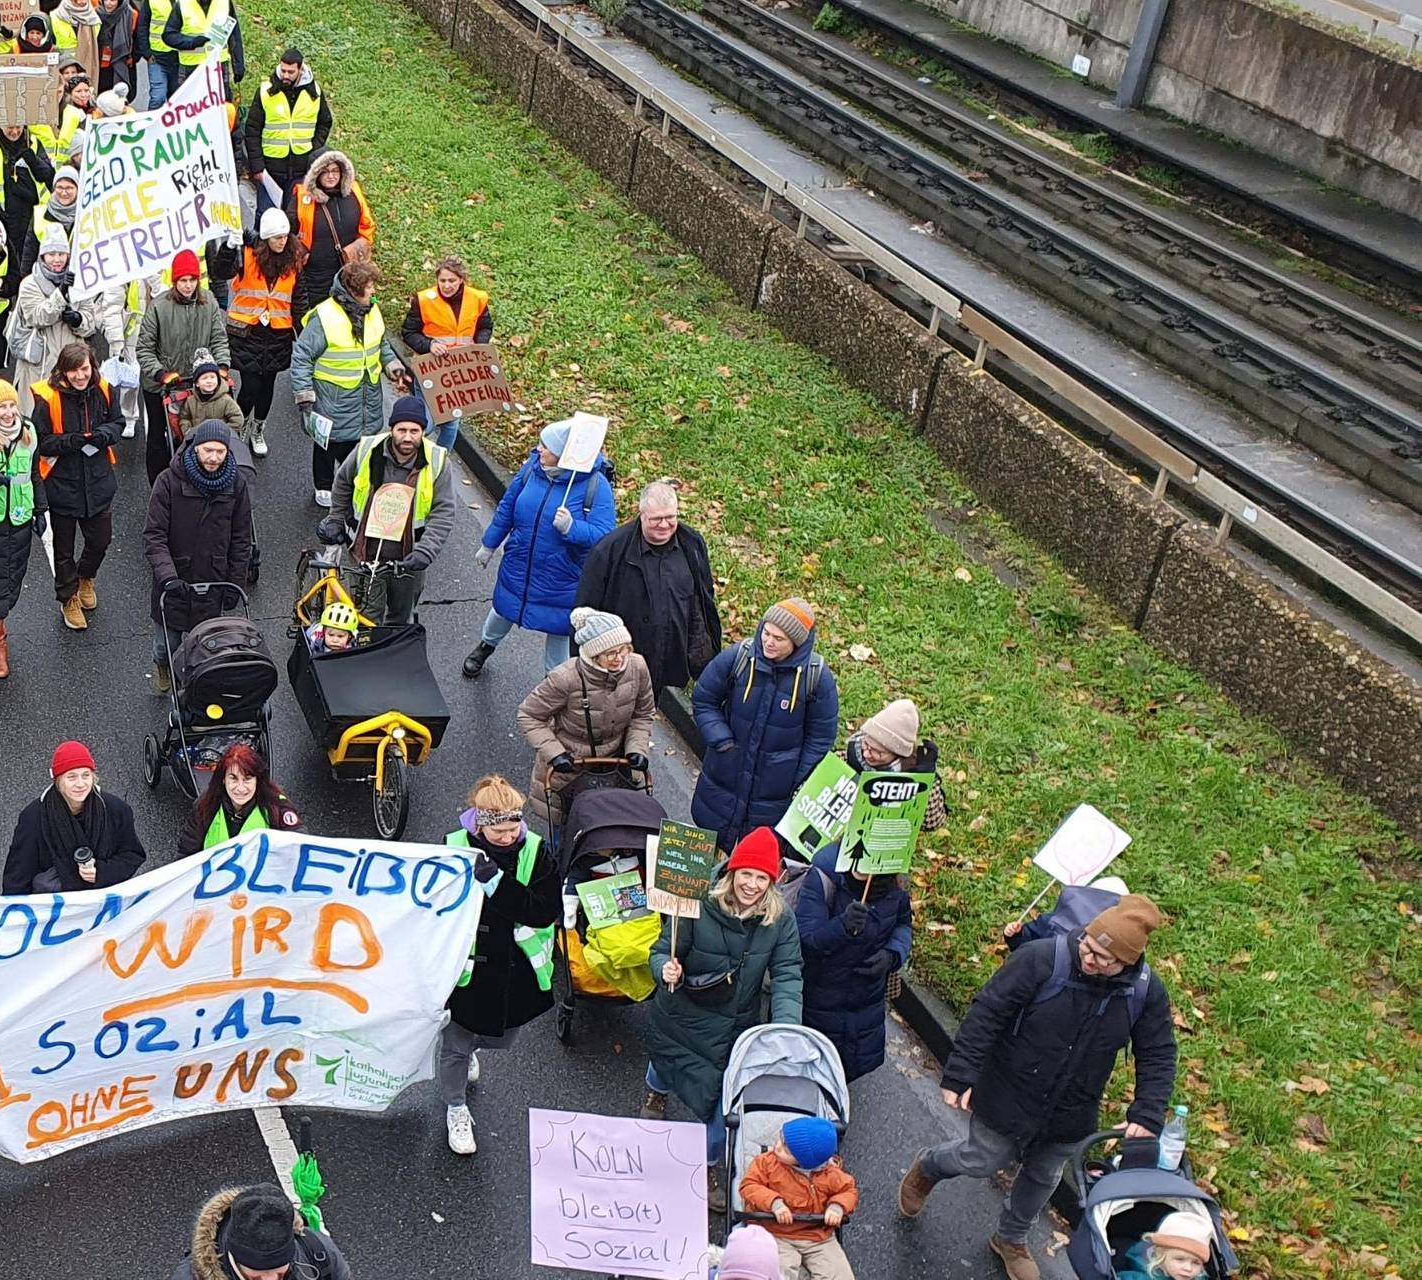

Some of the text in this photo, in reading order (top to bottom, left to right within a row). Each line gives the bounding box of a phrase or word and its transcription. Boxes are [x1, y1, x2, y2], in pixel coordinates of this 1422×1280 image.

[79, 193, 211, 290] BETREUER
[440, 365, 496, 388] GELDER
[435, 384, 511, 414] FAIRTEILEN
[869, 781, 920, 801] STEHT!
[797, 795, 845, 842] SOZIAL!
[26, 1047, 305, 1142] OHNE UNS
[559, 1187, 662, 1225] bleib(t)
